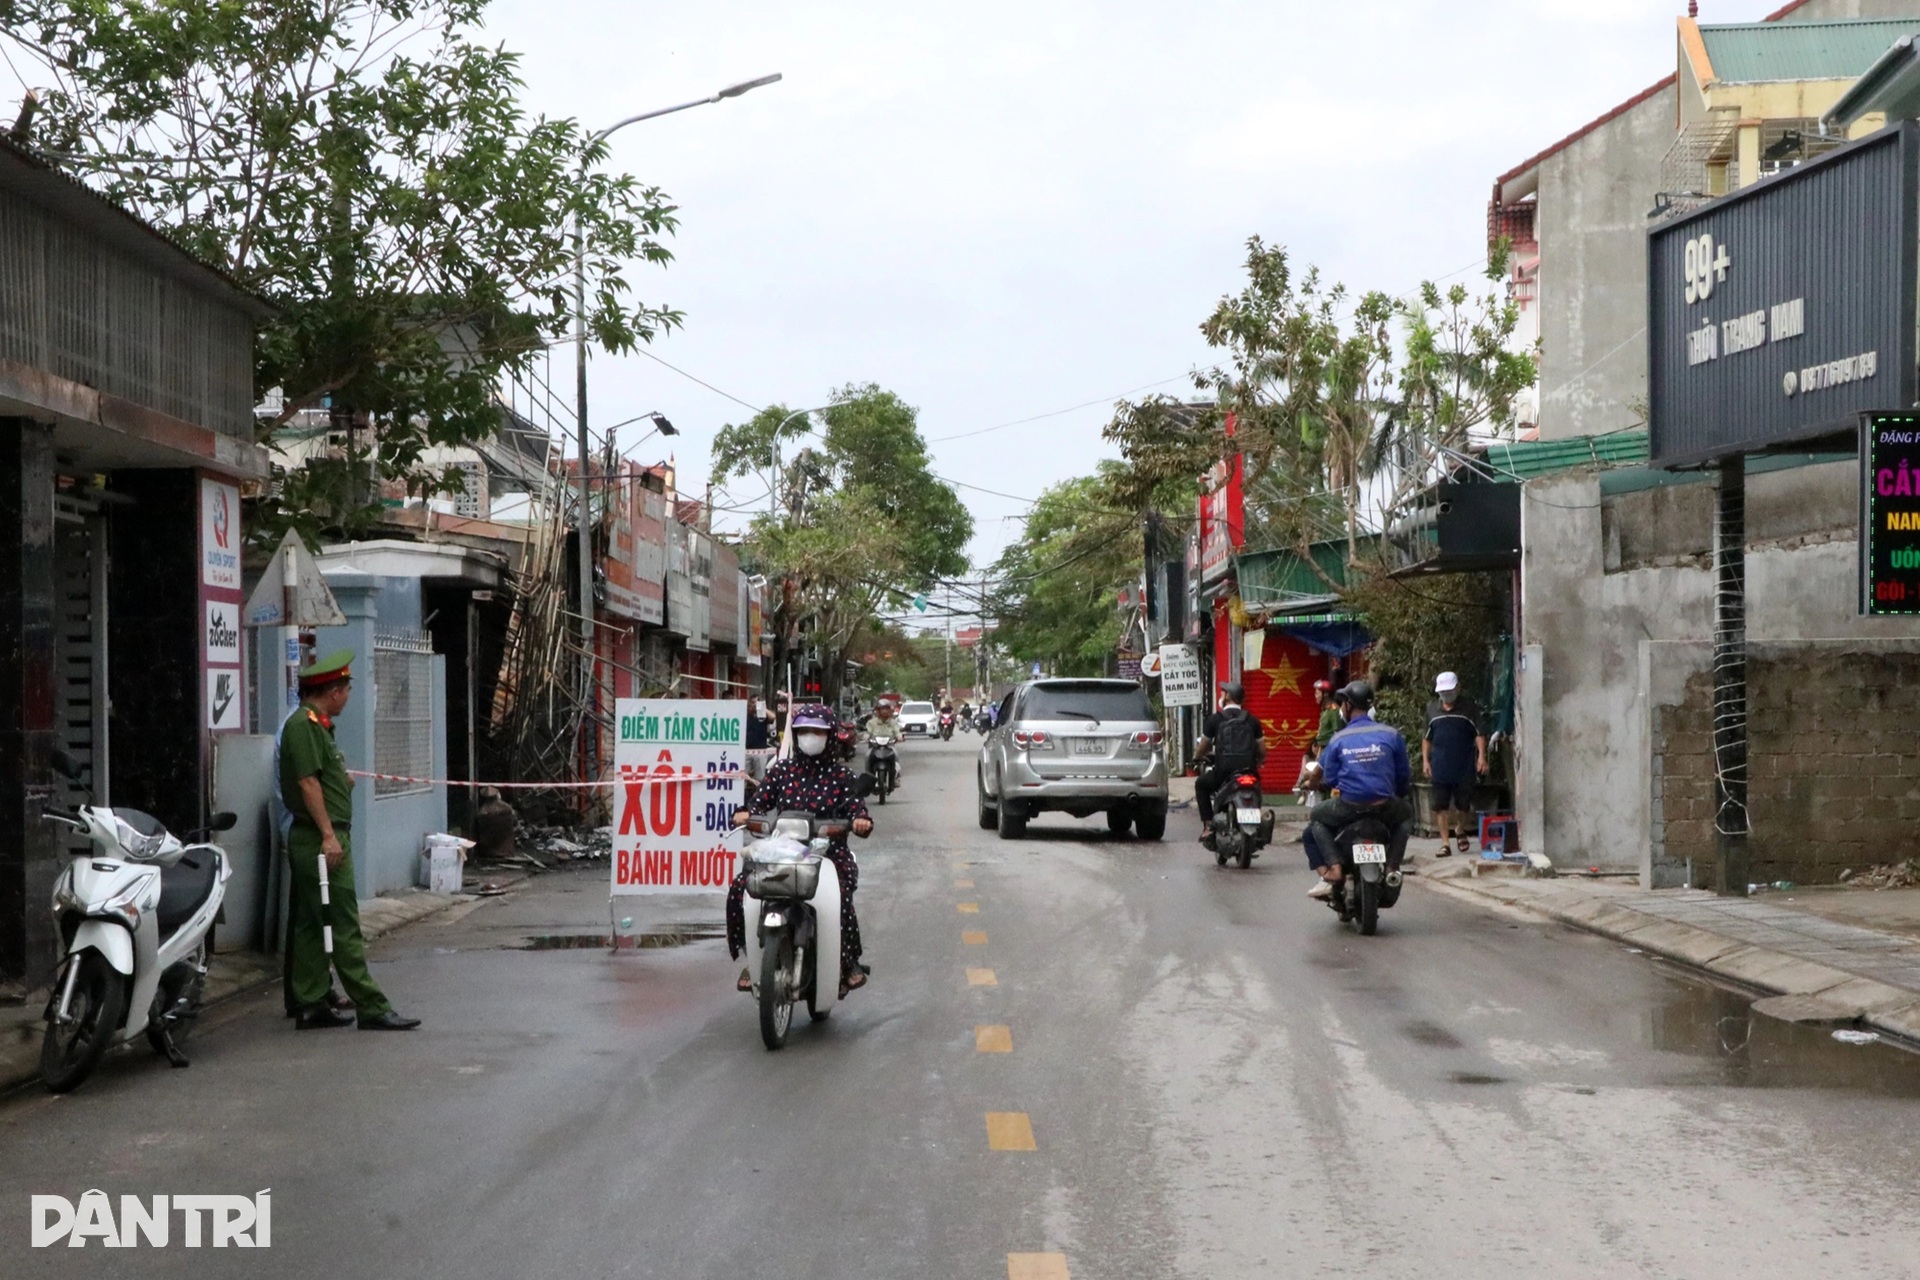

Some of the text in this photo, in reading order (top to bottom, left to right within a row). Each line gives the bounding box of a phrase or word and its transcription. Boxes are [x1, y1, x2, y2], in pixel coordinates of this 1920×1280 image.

[1684, 233, 1731, 304] 99+
[1686, 297, 1804, 367] THỜI TRANG NAM
[1879, 430, 1913, 446] ĐẶNG
[215, 674, 231, 702] NIKE
[1164, 669, 1197, 680] CẮT TÓC
[1165, 683, 1184, 692] NAM
[621, 707, 740, 742] ĐIỂM TÂM SÁNG
[618, 749, 693, 837] XÔI
[616, 843, 737, 887] BÁNH MƯỚT
